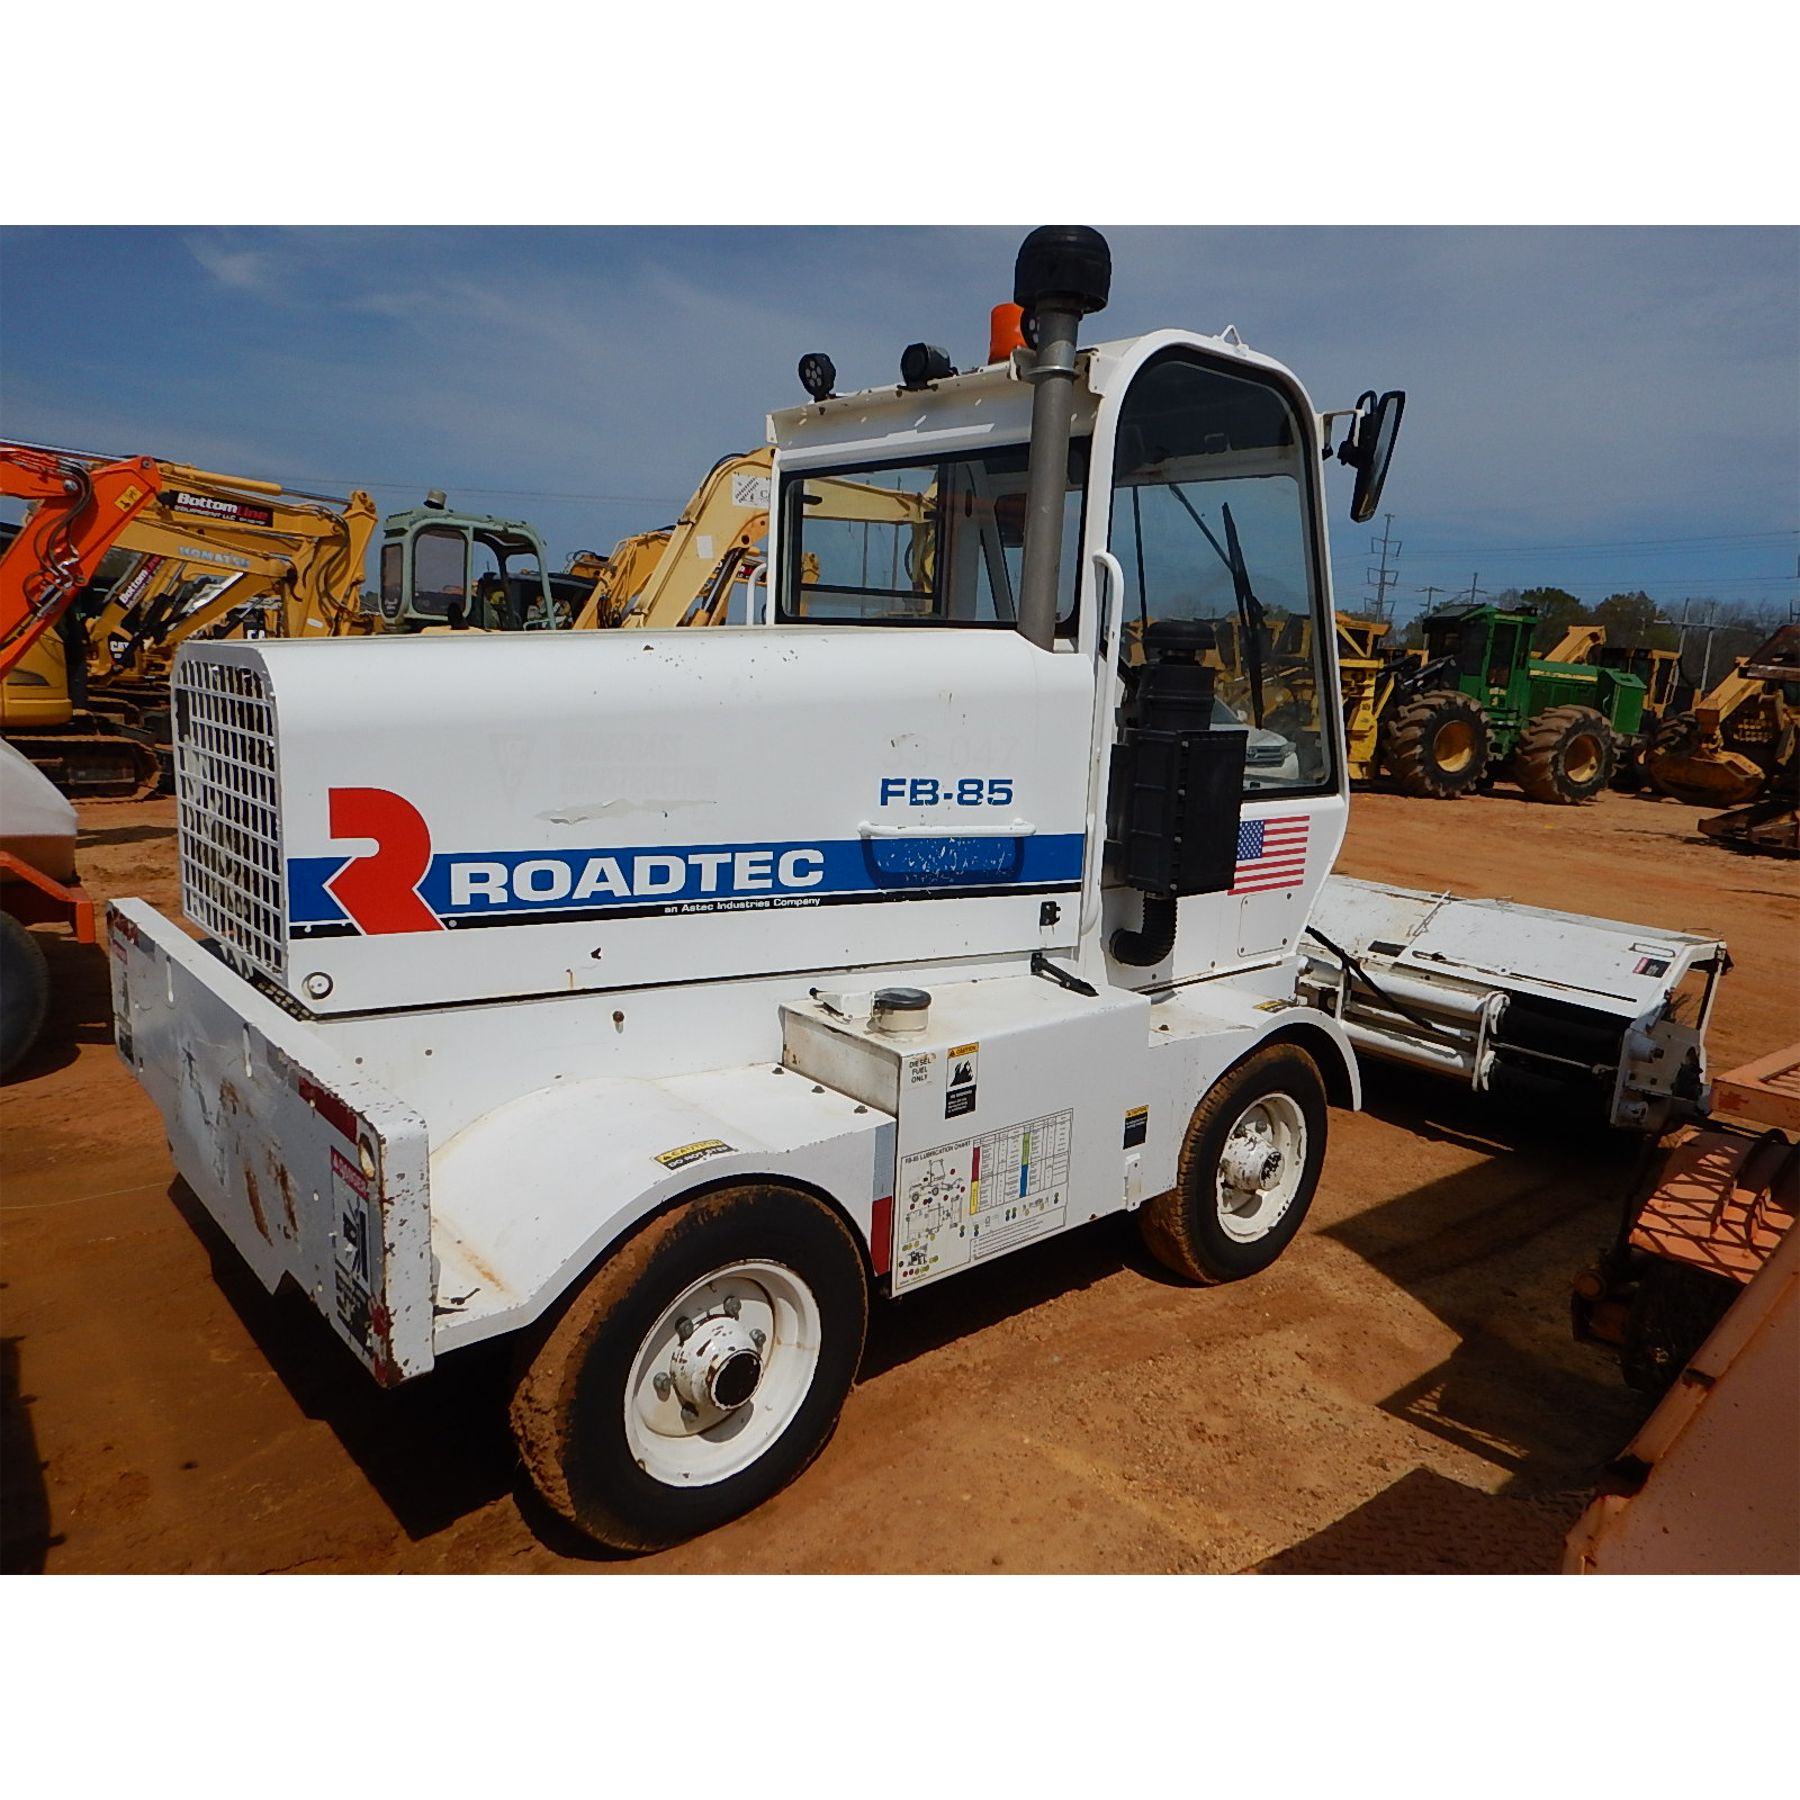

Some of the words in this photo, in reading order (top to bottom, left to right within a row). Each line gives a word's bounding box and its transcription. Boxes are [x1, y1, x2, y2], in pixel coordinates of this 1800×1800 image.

[880, 778, 1013, 806] FB-85
[450, 850, 825, 905] ROADTEC
[664, 906, 678, 914] an
[681, 902, 714, 913] Astec
[717, 899, 770, 911] Industries
[773, 897, 821, 907] Company
[909, 1058, 932, 1069] DIESEL
[912, 1066, 928, 1076] FUEL
[911, 1074, 928, 1084] ONLY
[667, 1159, 684, 1168] DO
